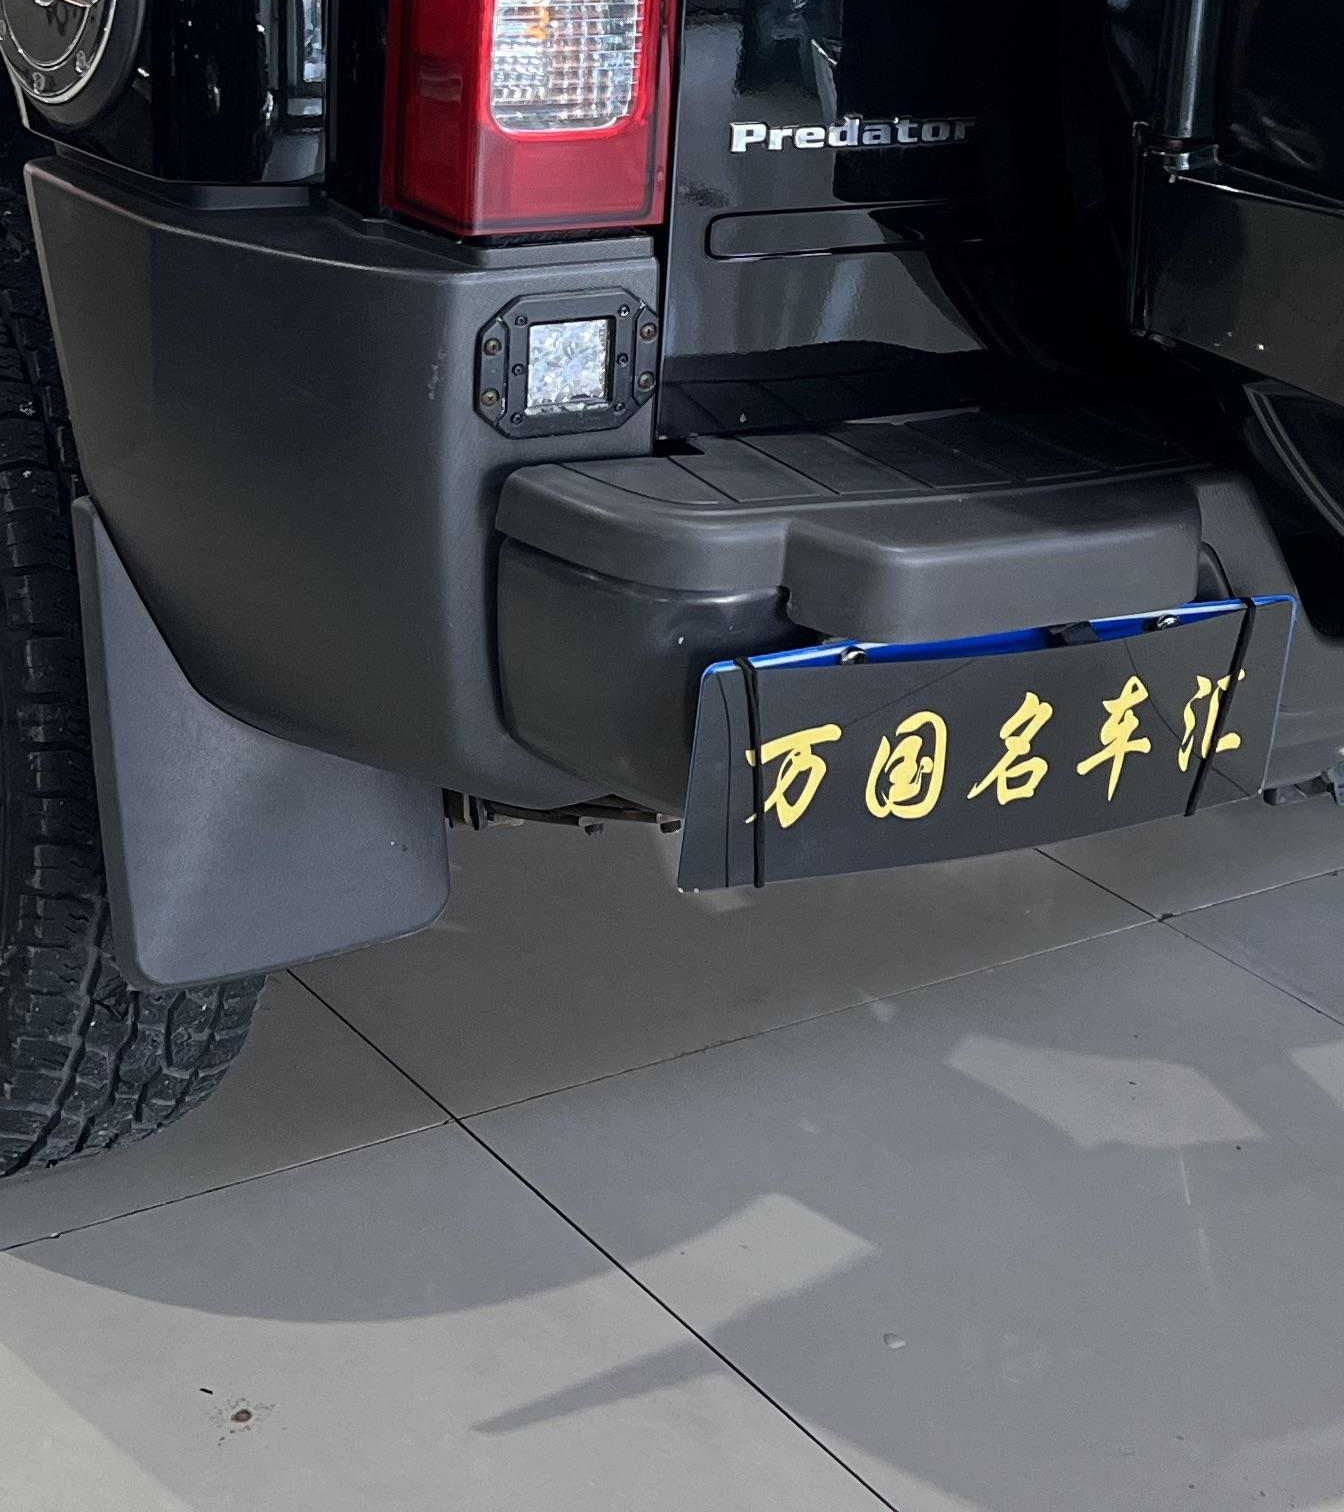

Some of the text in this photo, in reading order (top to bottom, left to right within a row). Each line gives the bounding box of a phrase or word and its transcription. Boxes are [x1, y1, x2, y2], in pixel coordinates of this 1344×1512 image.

[729, 112, 976, 154] Predator
[744, 667, 1247, 830] 万国名车汇
